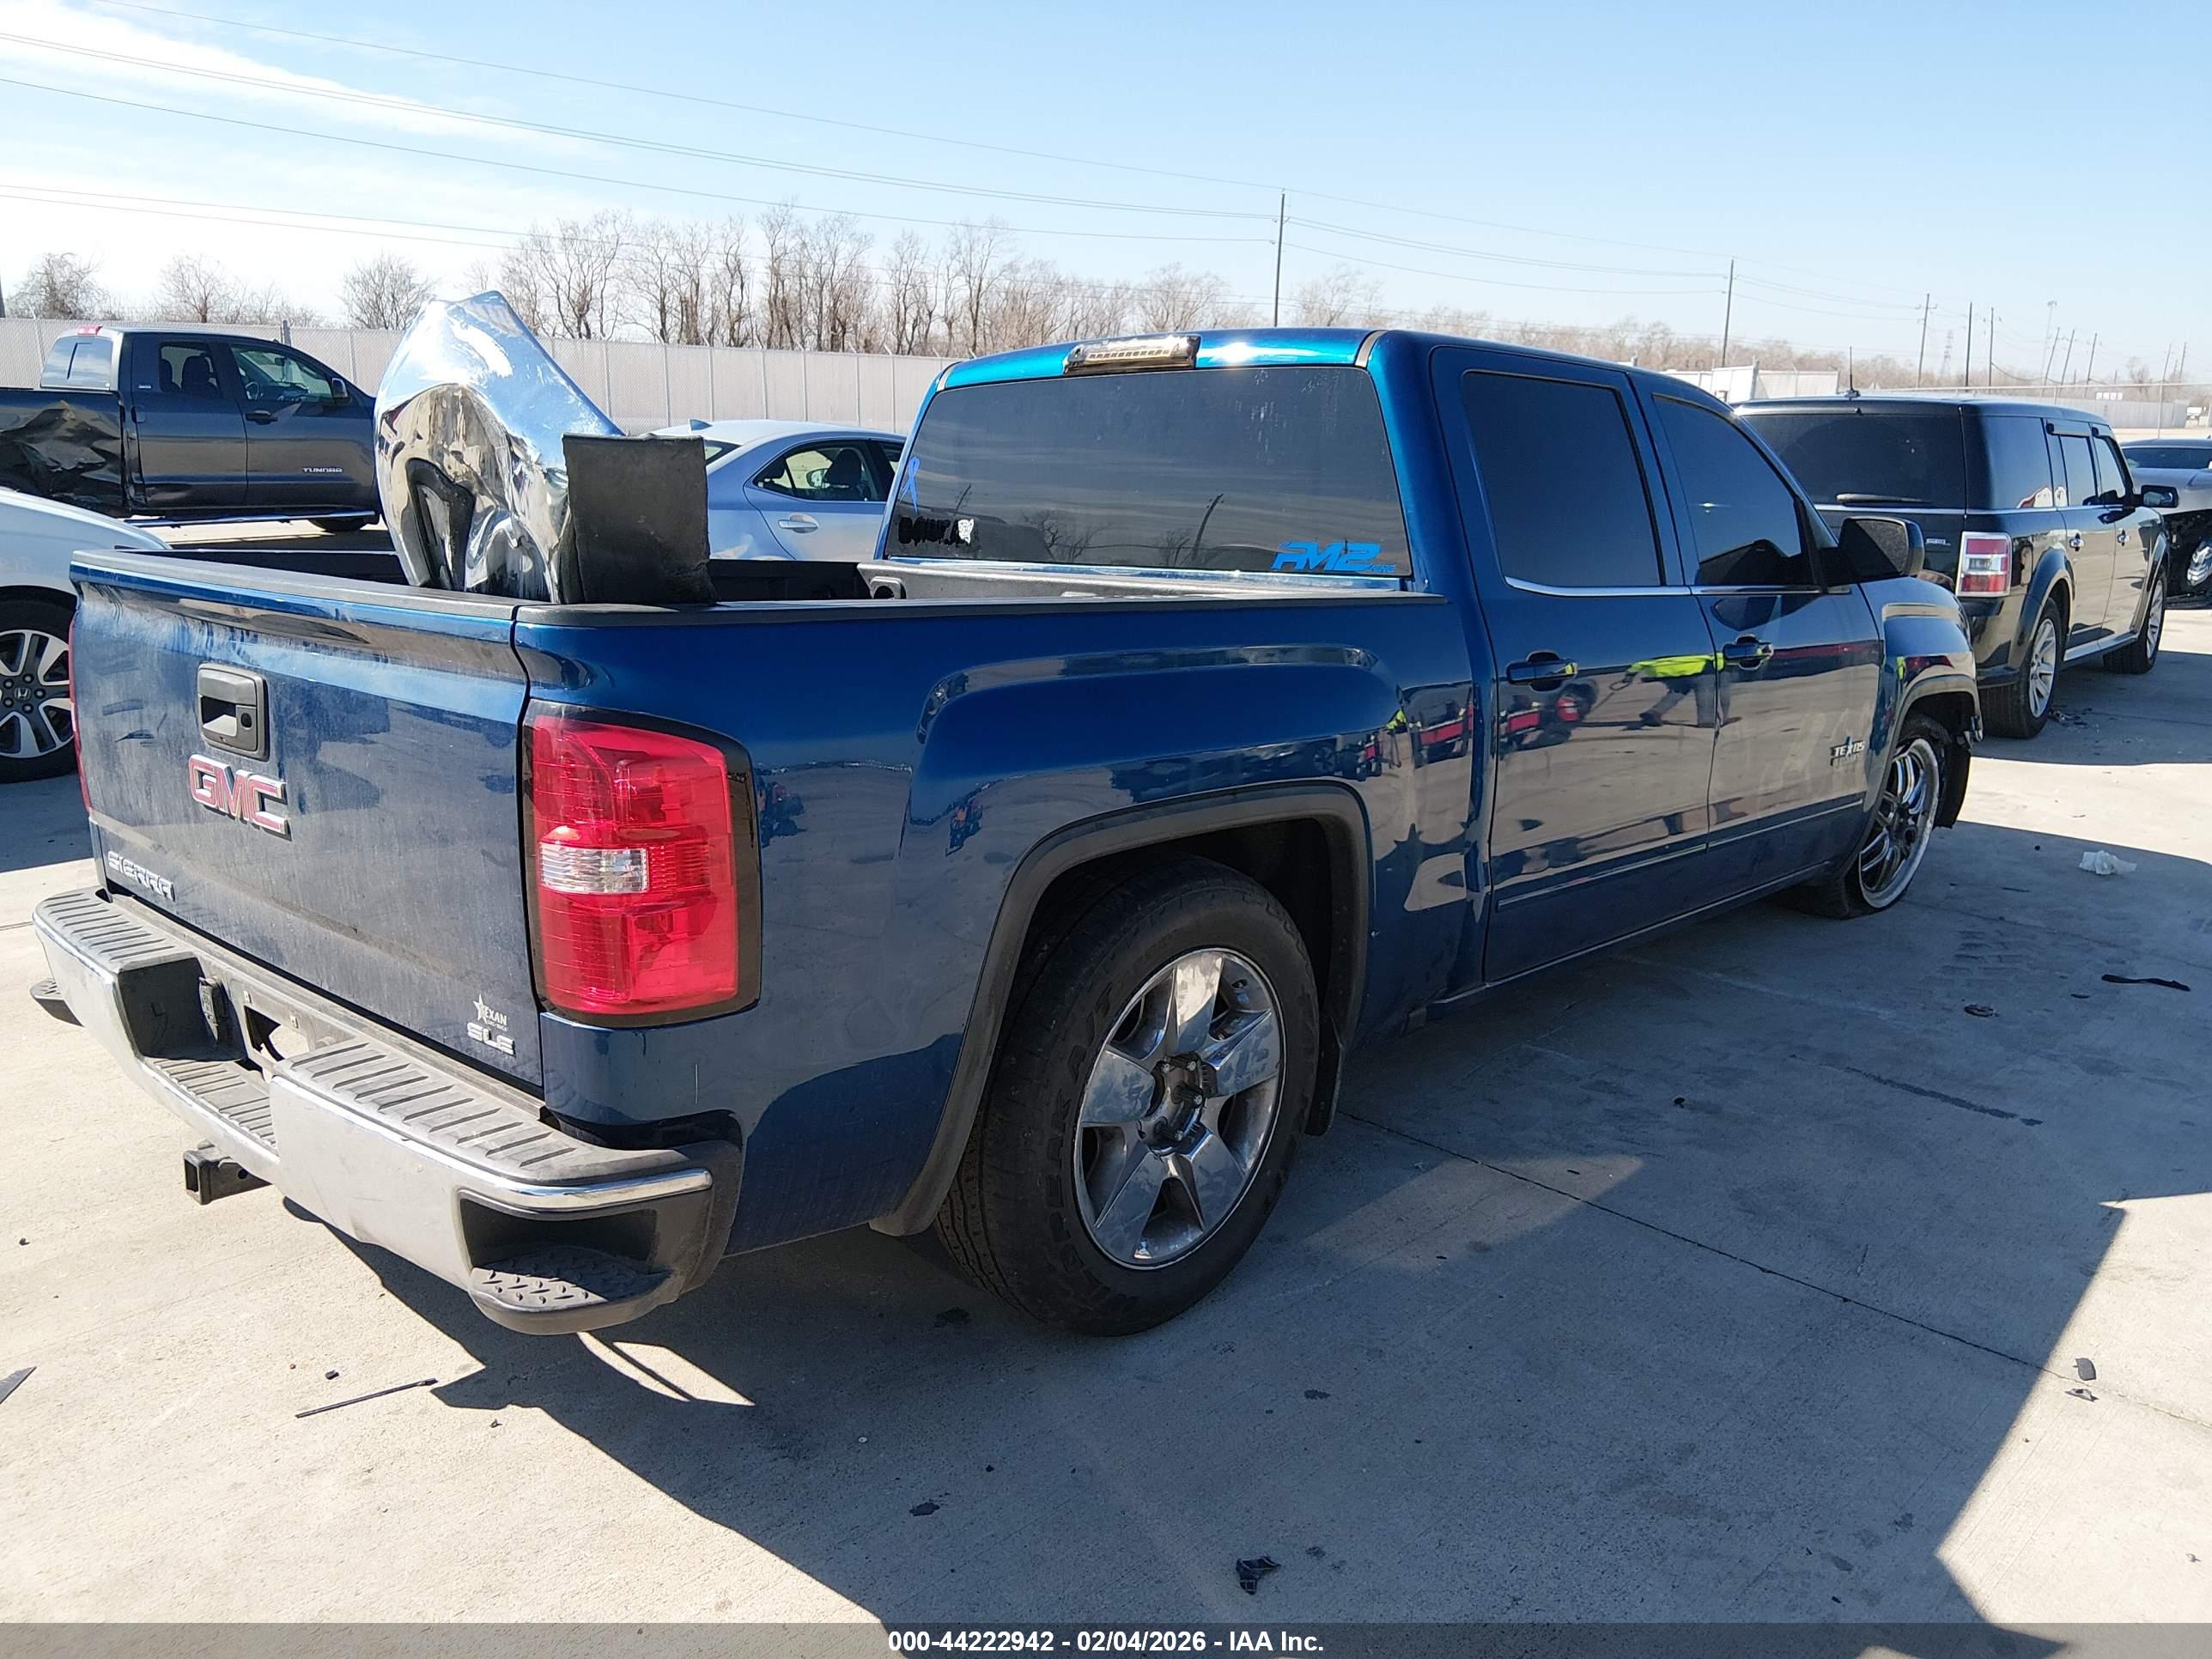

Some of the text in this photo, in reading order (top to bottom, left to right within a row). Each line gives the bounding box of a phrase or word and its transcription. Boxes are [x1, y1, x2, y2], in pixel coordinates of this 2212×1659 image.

[188, 754, 290, 838] GMC
[107, 851, 175, 901] SIERRA
[467, 1022, 515, 1054] SLE
